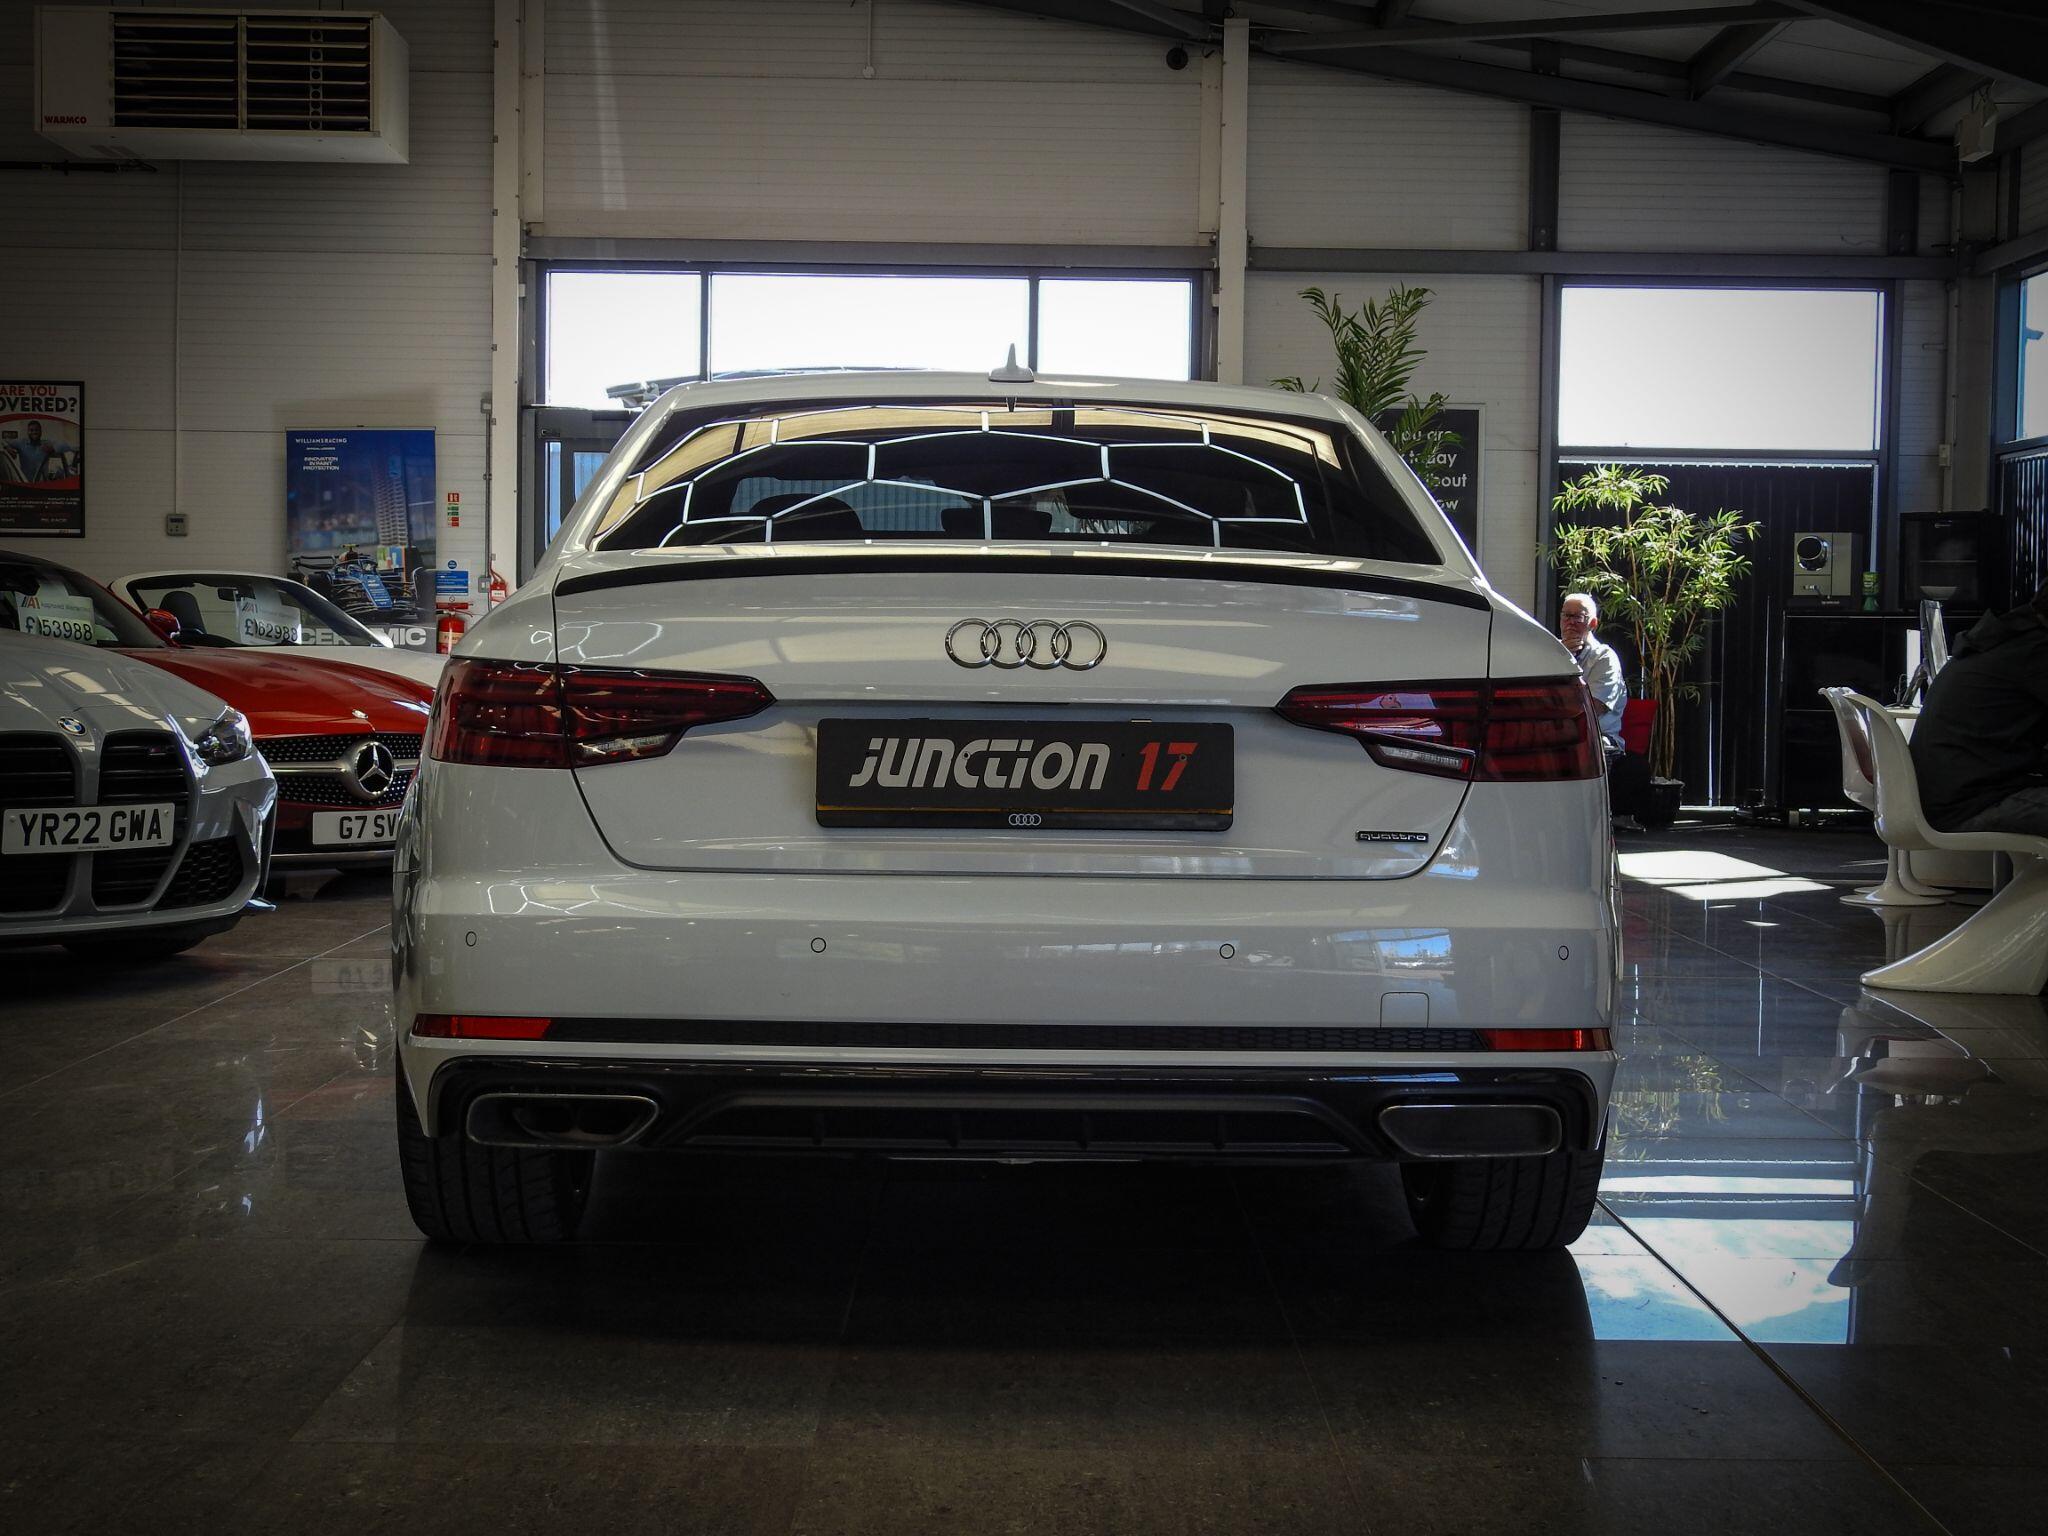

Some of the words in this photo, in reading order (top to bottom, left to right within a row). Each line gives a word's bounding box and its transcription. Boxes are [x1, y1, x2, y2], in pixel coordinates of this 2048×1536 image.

[44, 116, 87, 124] WARMCO
[0, 386, 25, 397] ARE
[30, 386, 57, 397] YOU
[1426, 473, 1469, 488] bout
[301, 627, 426, 646] CERMIC
[1136, 741, 1199, 790] 17
[20, 812, 101, 846] YR22
[109, 808, 162, 843] GWA
[339, 815, 368, 839] G7
[373, 813, 400, 838] SV
[1359, 832, 1427, 841] quattro
